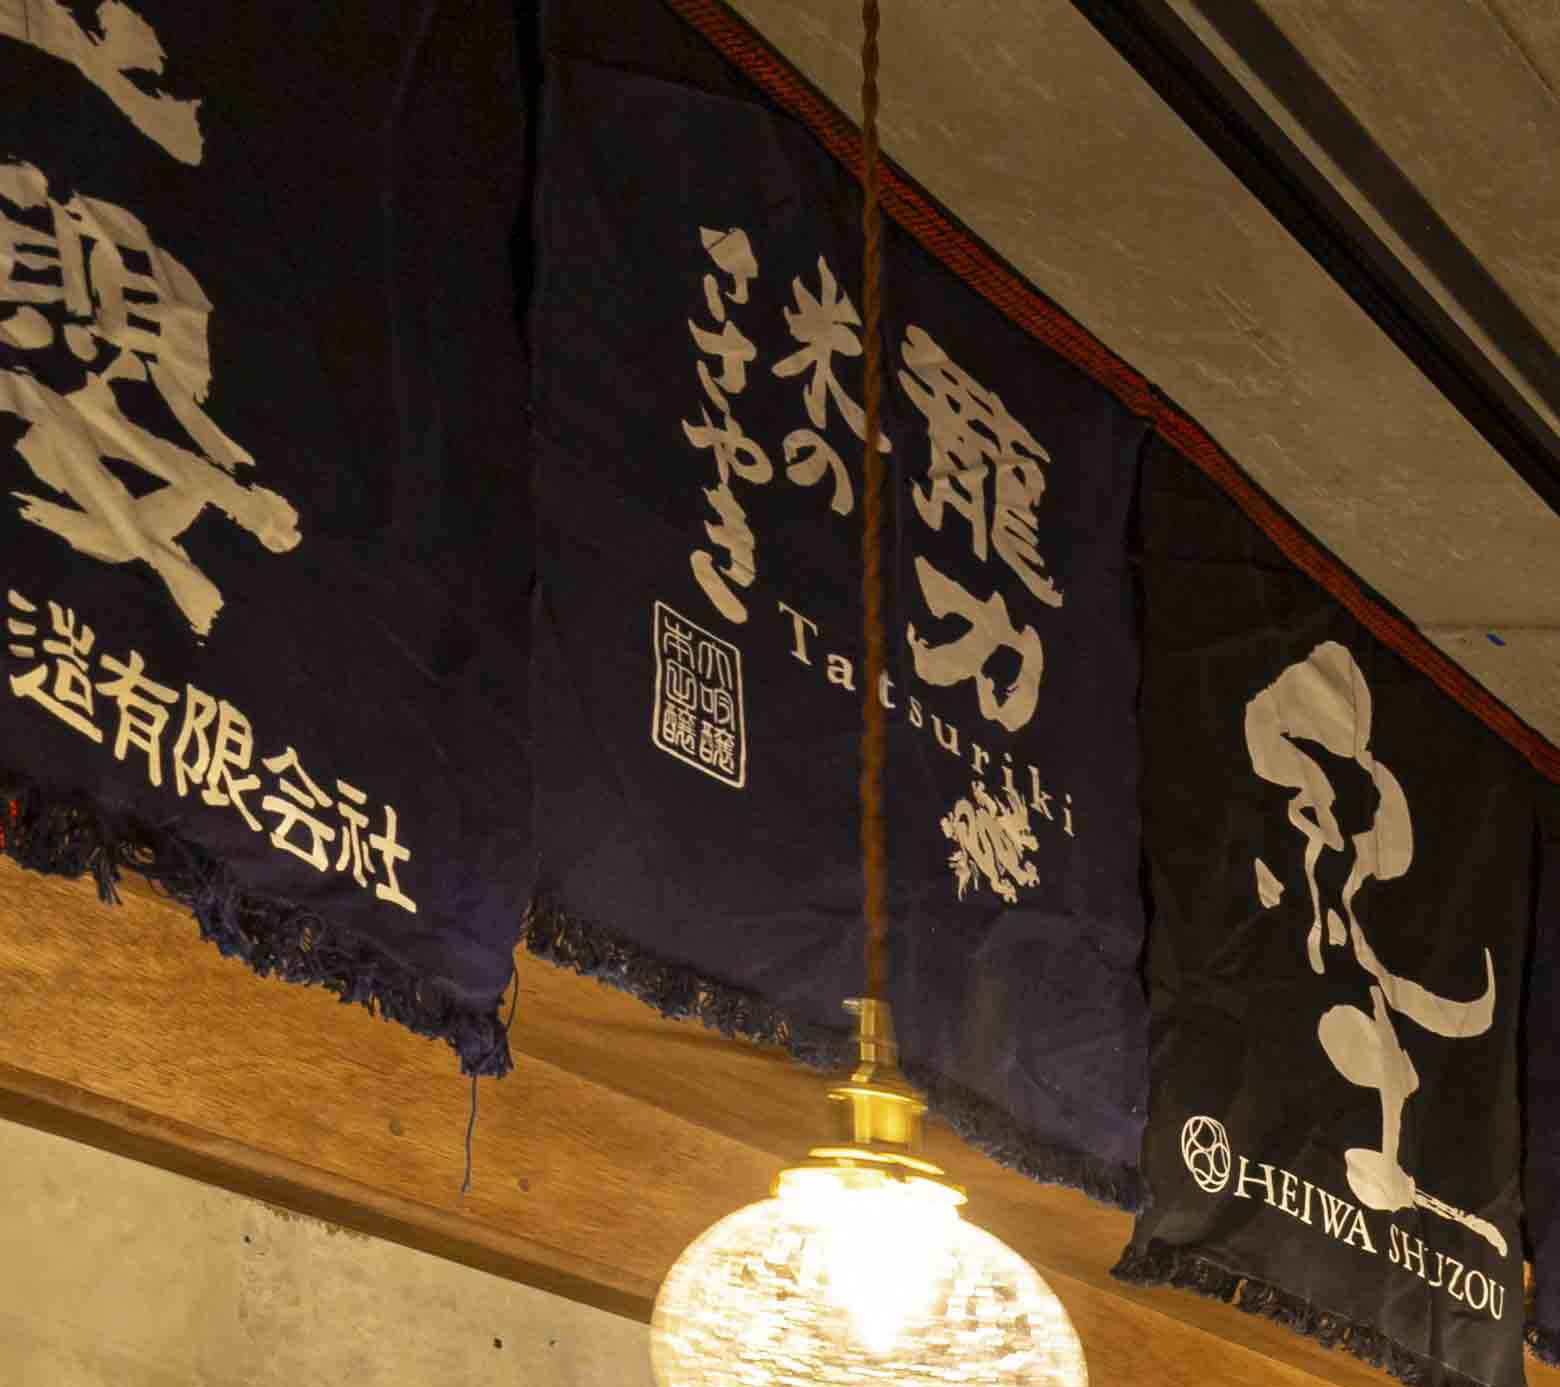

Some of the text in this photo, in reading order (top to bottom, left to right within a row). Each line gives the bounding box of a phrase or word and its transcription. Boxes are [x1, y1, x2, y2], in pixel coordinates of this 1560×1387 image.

[6, 590, 418, 913] 造有限会社
[778, 600, 1076, 838] Tatsuriki
[1236, 1159, 1378, 1256] HEIWA
